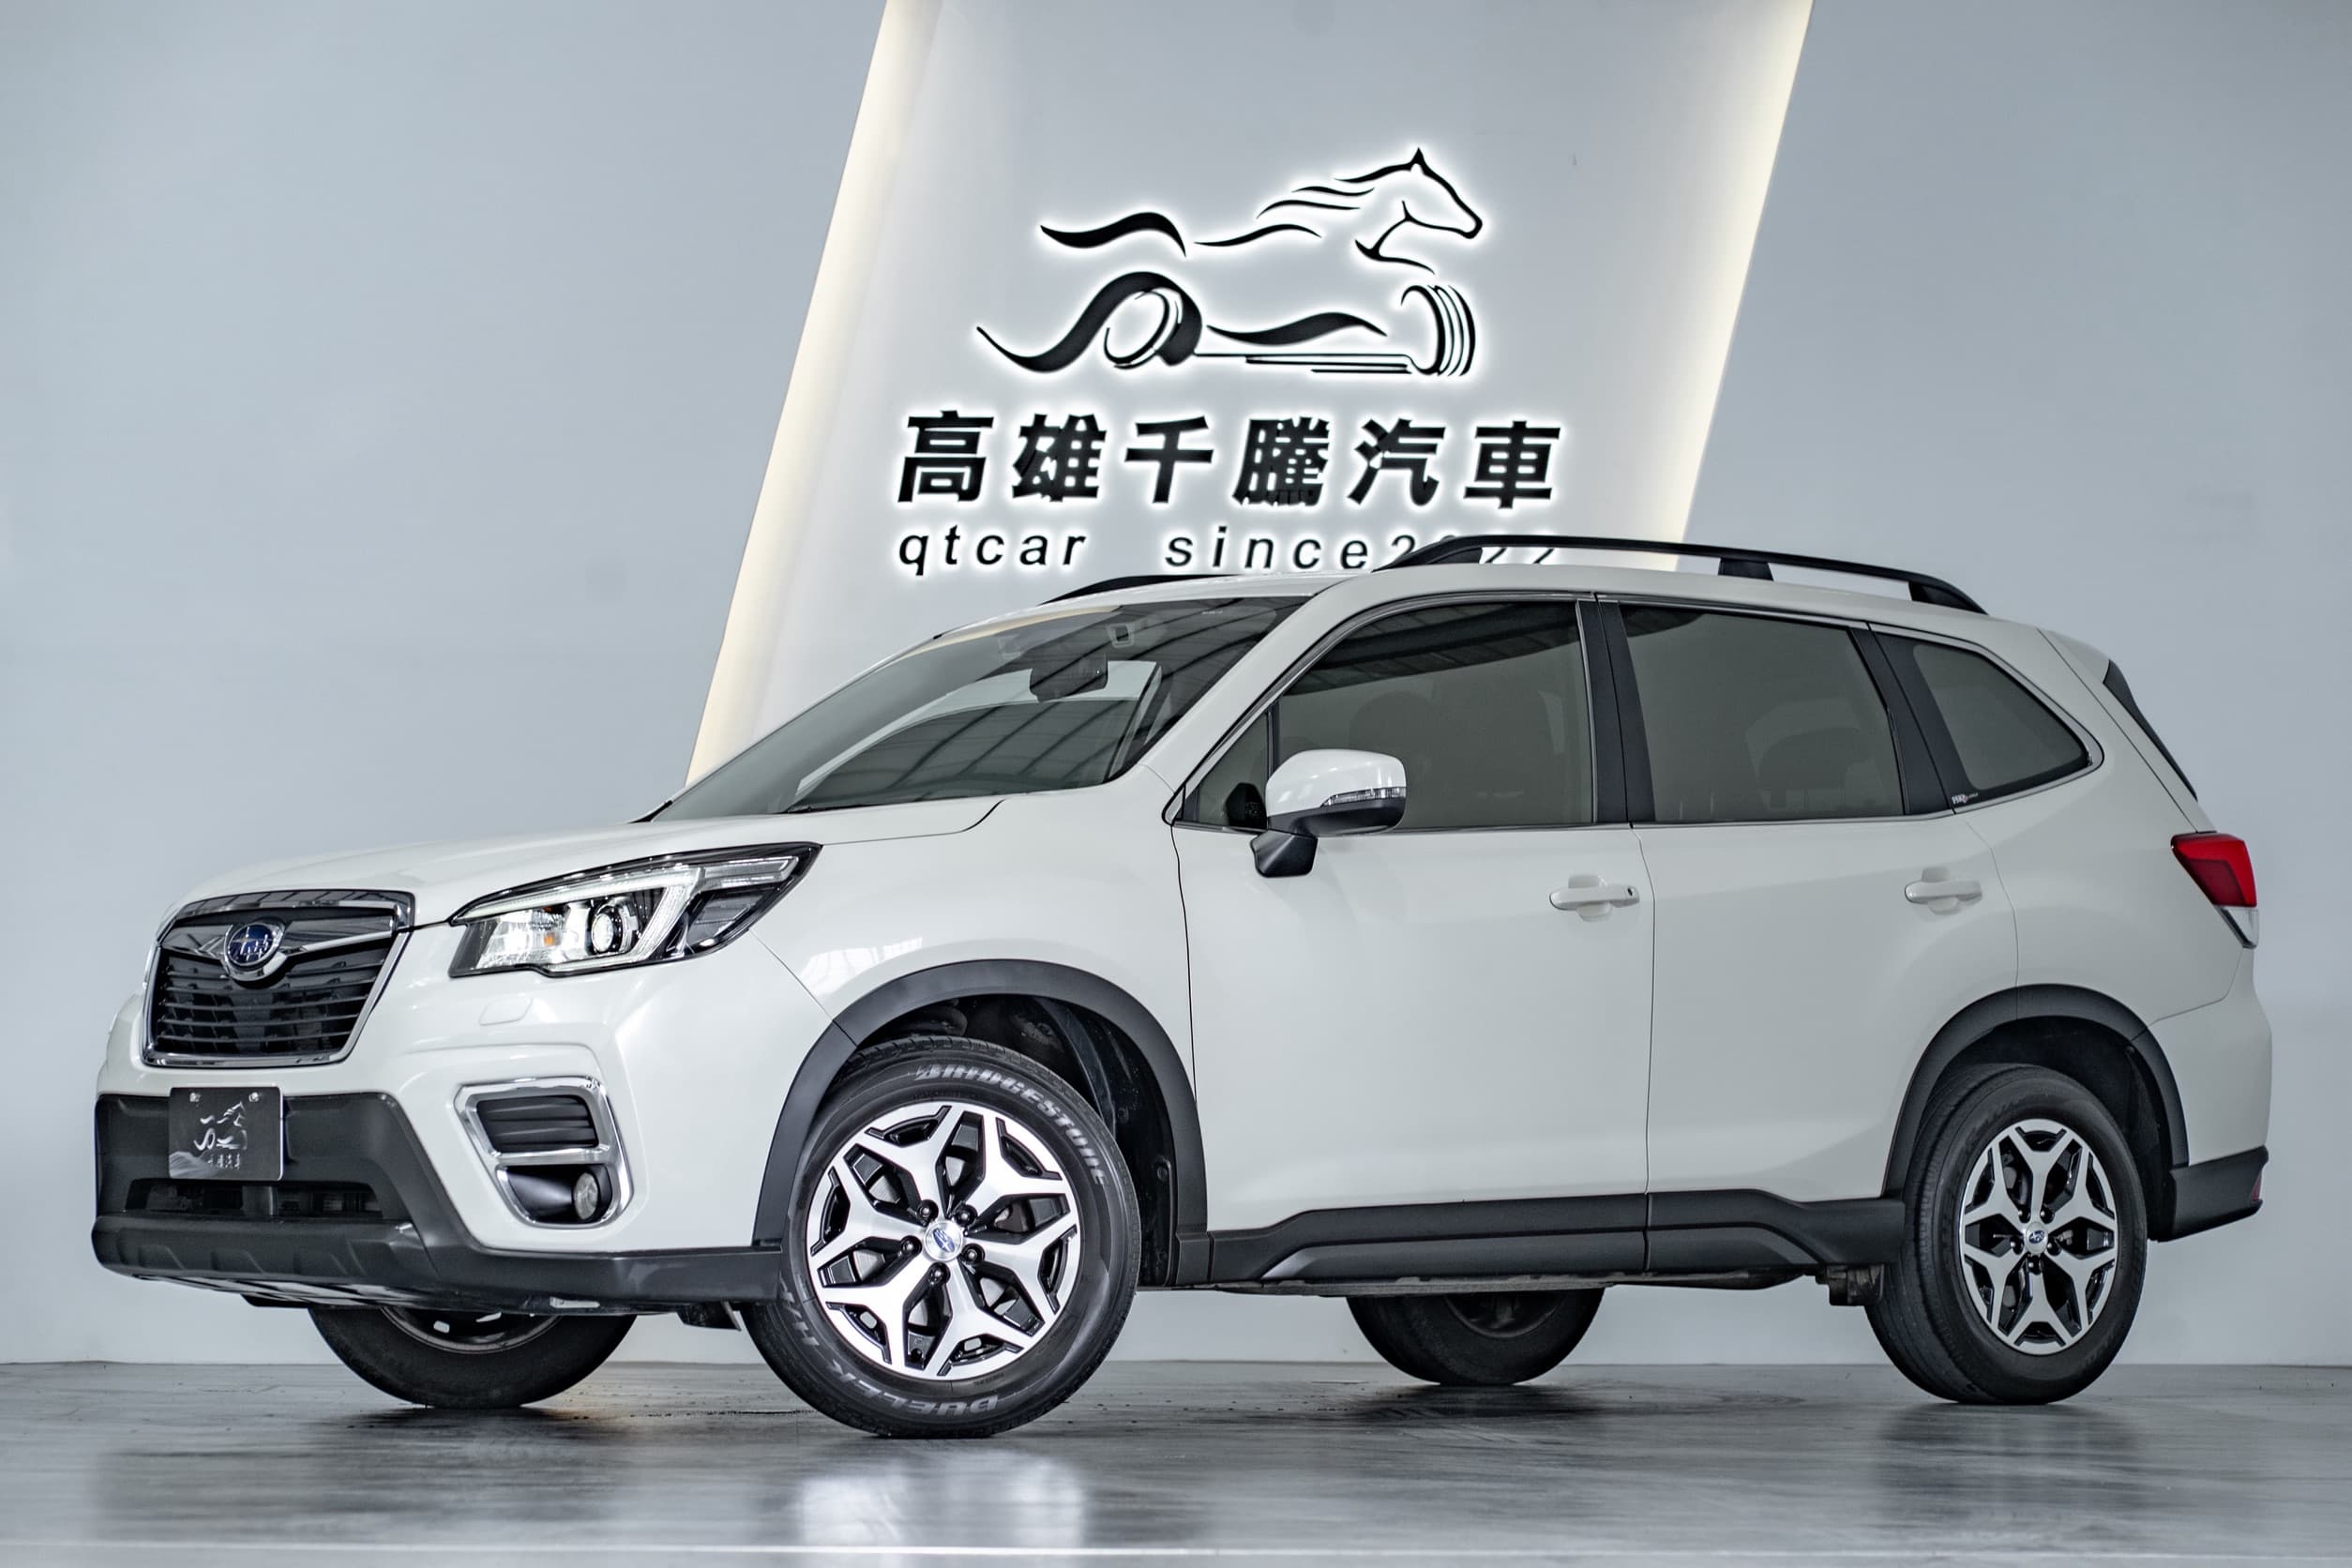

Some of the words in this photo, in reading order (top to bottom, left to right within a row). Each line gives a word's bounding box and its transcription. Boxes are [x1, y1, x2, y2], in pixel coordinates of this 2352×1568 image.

[897, 410, 1561, 509] 高雄千騰汽車
[897, 524, 1088, 575] qtcar
[1165, 526, 1555, 570] since2
[915, 1064, 1109, 1185] BRIDGESTONE
[831, 1358, 1000, 1417] DUELER
